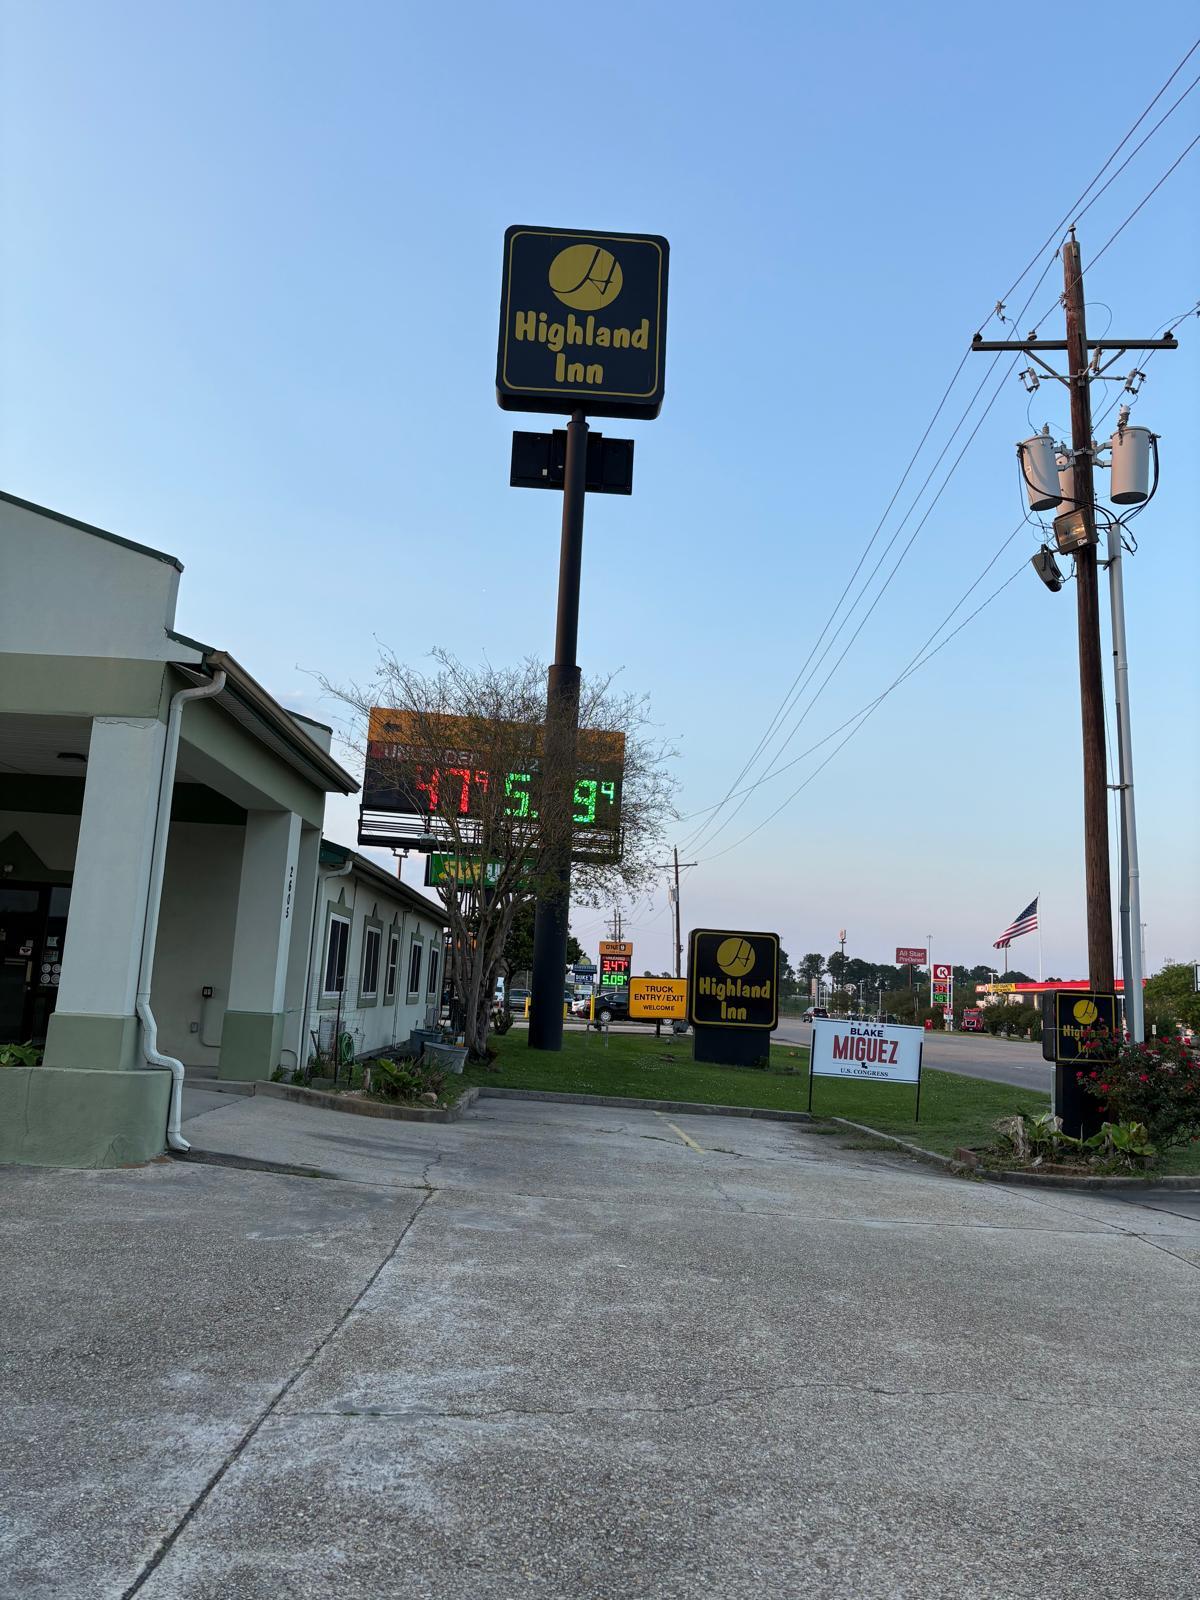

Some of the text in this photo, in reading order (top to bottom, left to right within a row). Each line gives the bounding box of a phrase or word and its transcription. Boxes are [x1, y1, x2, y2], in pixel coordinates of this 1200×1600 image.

[515, 311, 649, 351] Highland
[556, 353, 603, 384] Inn
[645, 985, 674, 993] TRUCK
[699, 976, 771, 1000] Highland
[721, 1001, 747, 1019] Inn
[850, 1027, 884, 1038] BLAKE
[833, 1035, 899, 1065] MIGUEZ
[840, 1067, 889, 1077] U.S. CONGRESS
